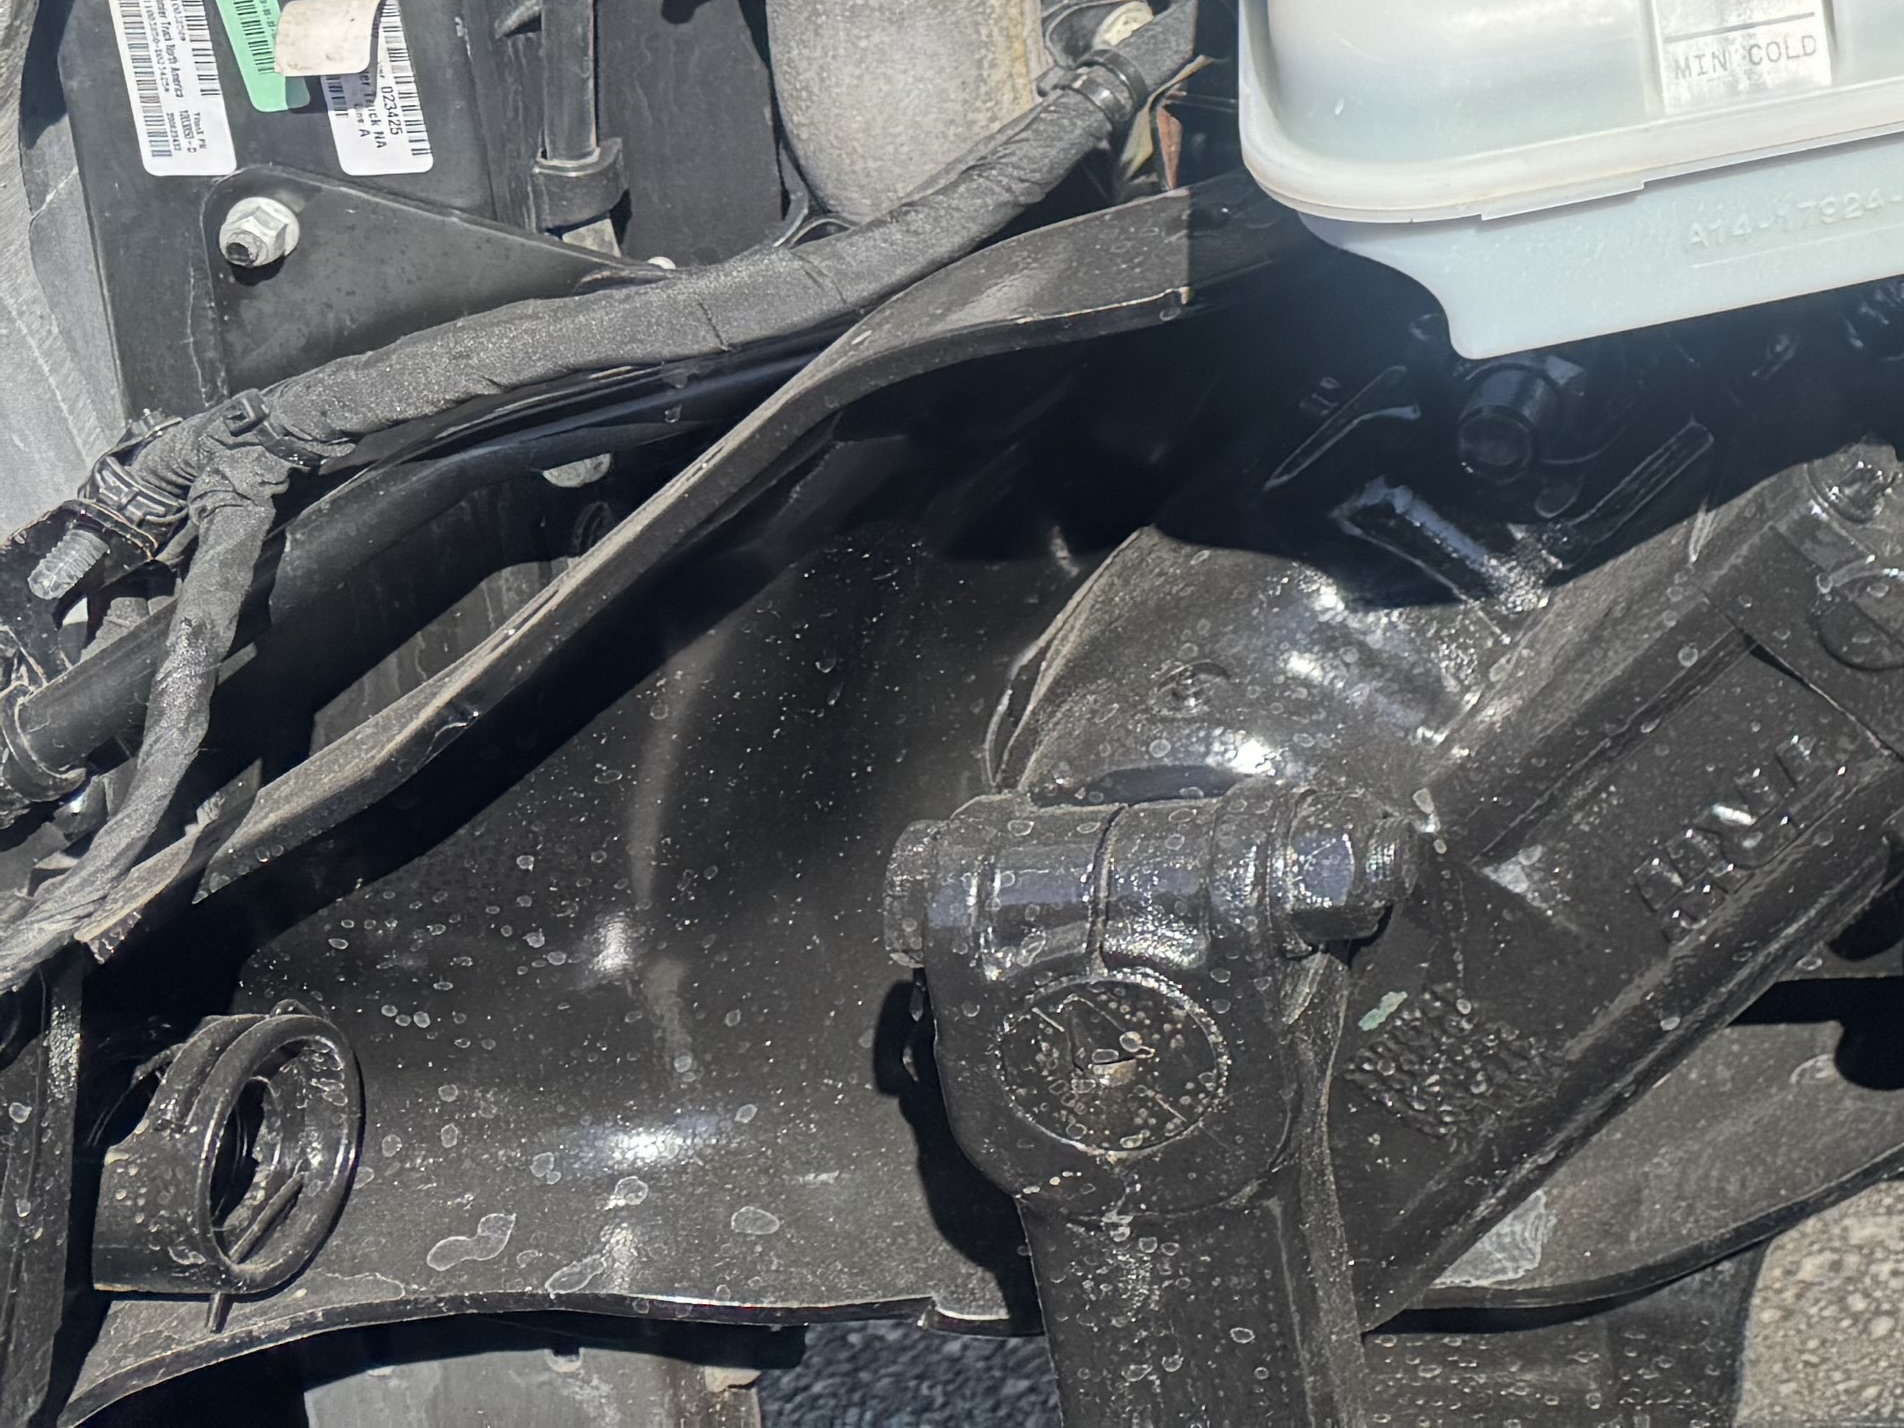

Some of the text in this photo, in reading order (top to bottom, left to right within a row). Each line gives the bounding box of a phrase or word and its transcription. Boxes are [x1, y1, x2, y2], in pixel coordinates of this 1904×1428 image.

[1675, 35, 1817, 80] MIN COLD
[381, 86, 403, 135] 023425
[359, 129, 370, 137] A
[374, 131, 387, 148] NA
